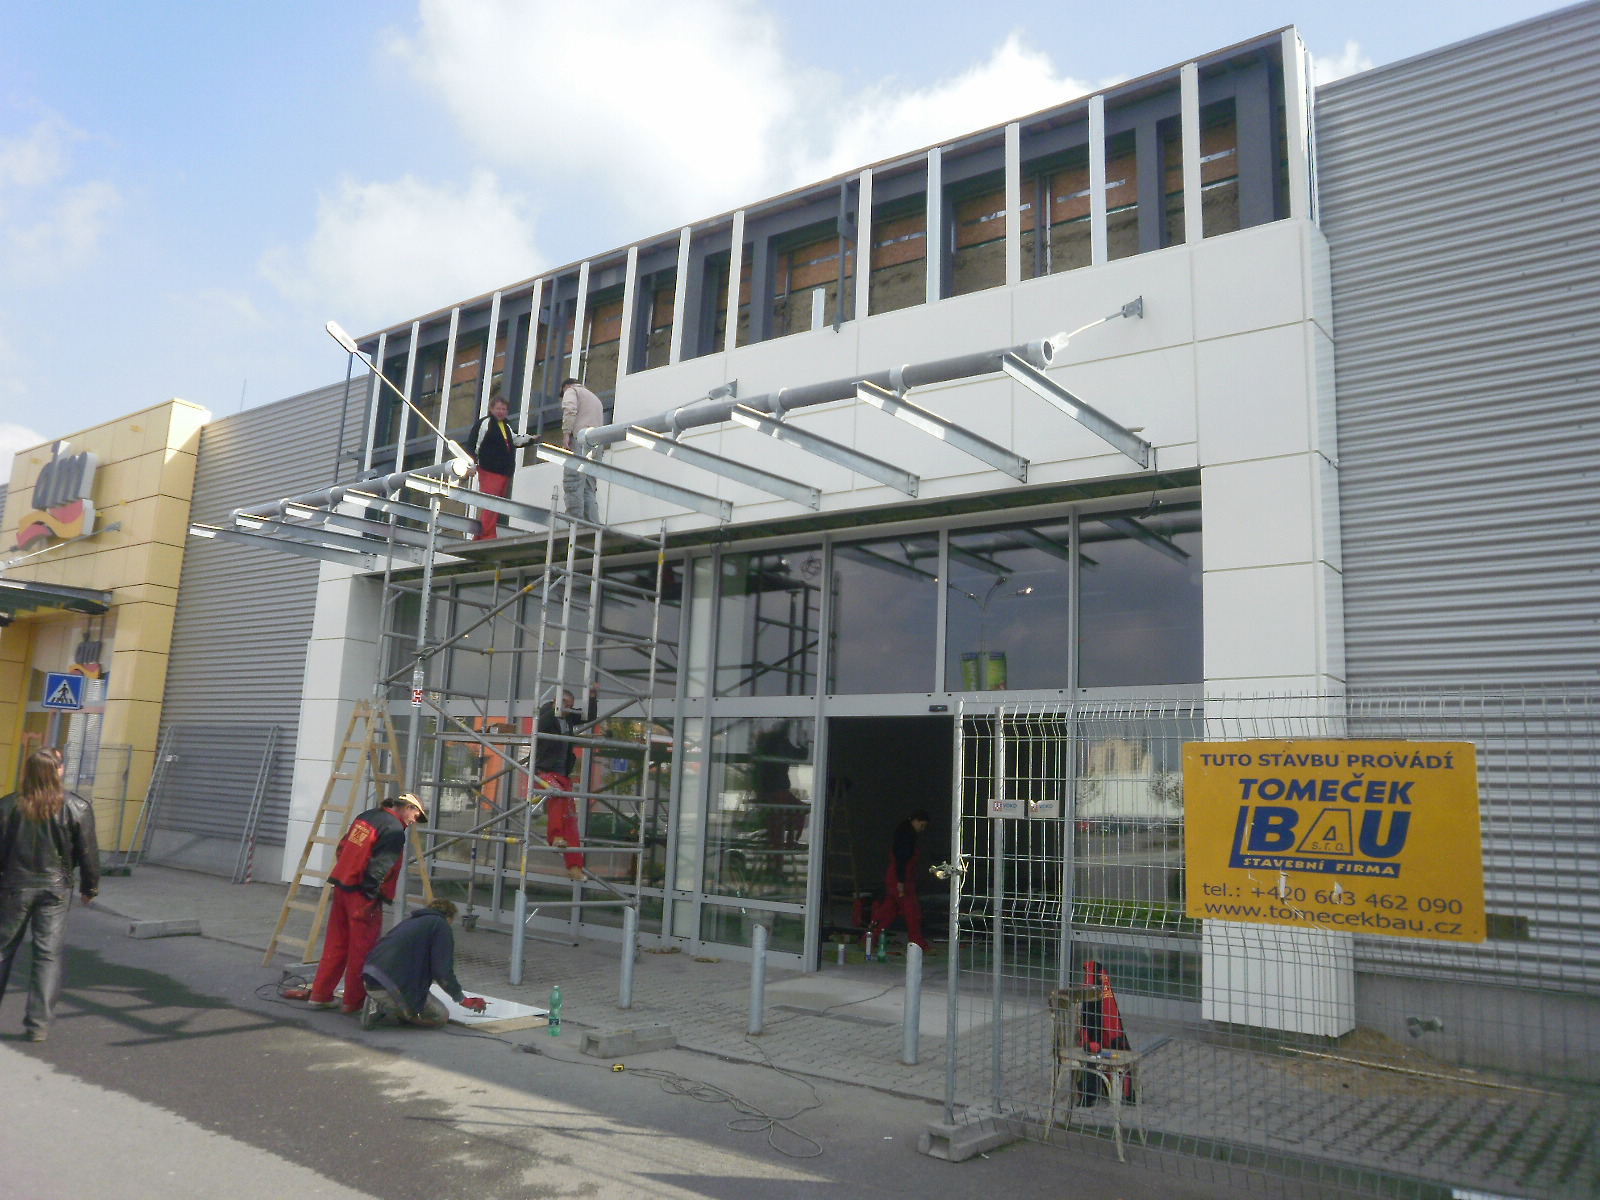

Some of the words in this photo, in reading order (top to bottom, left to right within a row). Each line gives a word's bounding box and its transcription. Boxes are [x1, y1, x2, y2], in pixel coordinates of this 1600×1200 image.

[32, 440, 88, 511] dm
[1200, 753, 1253, 767] TUTO
[1258, 753, 1340, 768] STAVBU
[1347, 750, 1455, 770] PROVÁDÍ
[1239, 772, 1416, 805] TOMEČEK
[1246, 806, 1412, 859] BAU
[1243, 858, 1325, 871] STAVEBNÍ
[1335, 863, 1395, 875] FIRMA
[1203, 882, 1241, 898] tel.:
[1251, 885, 1307, 902] +420
[1314, 889, 1356, 906] 603
[1365, 892, 1409, 912] 462
[1417, 897, 1463, 915] 090
[1205, 902, 1463, 934] www.tomecekbau.cz
